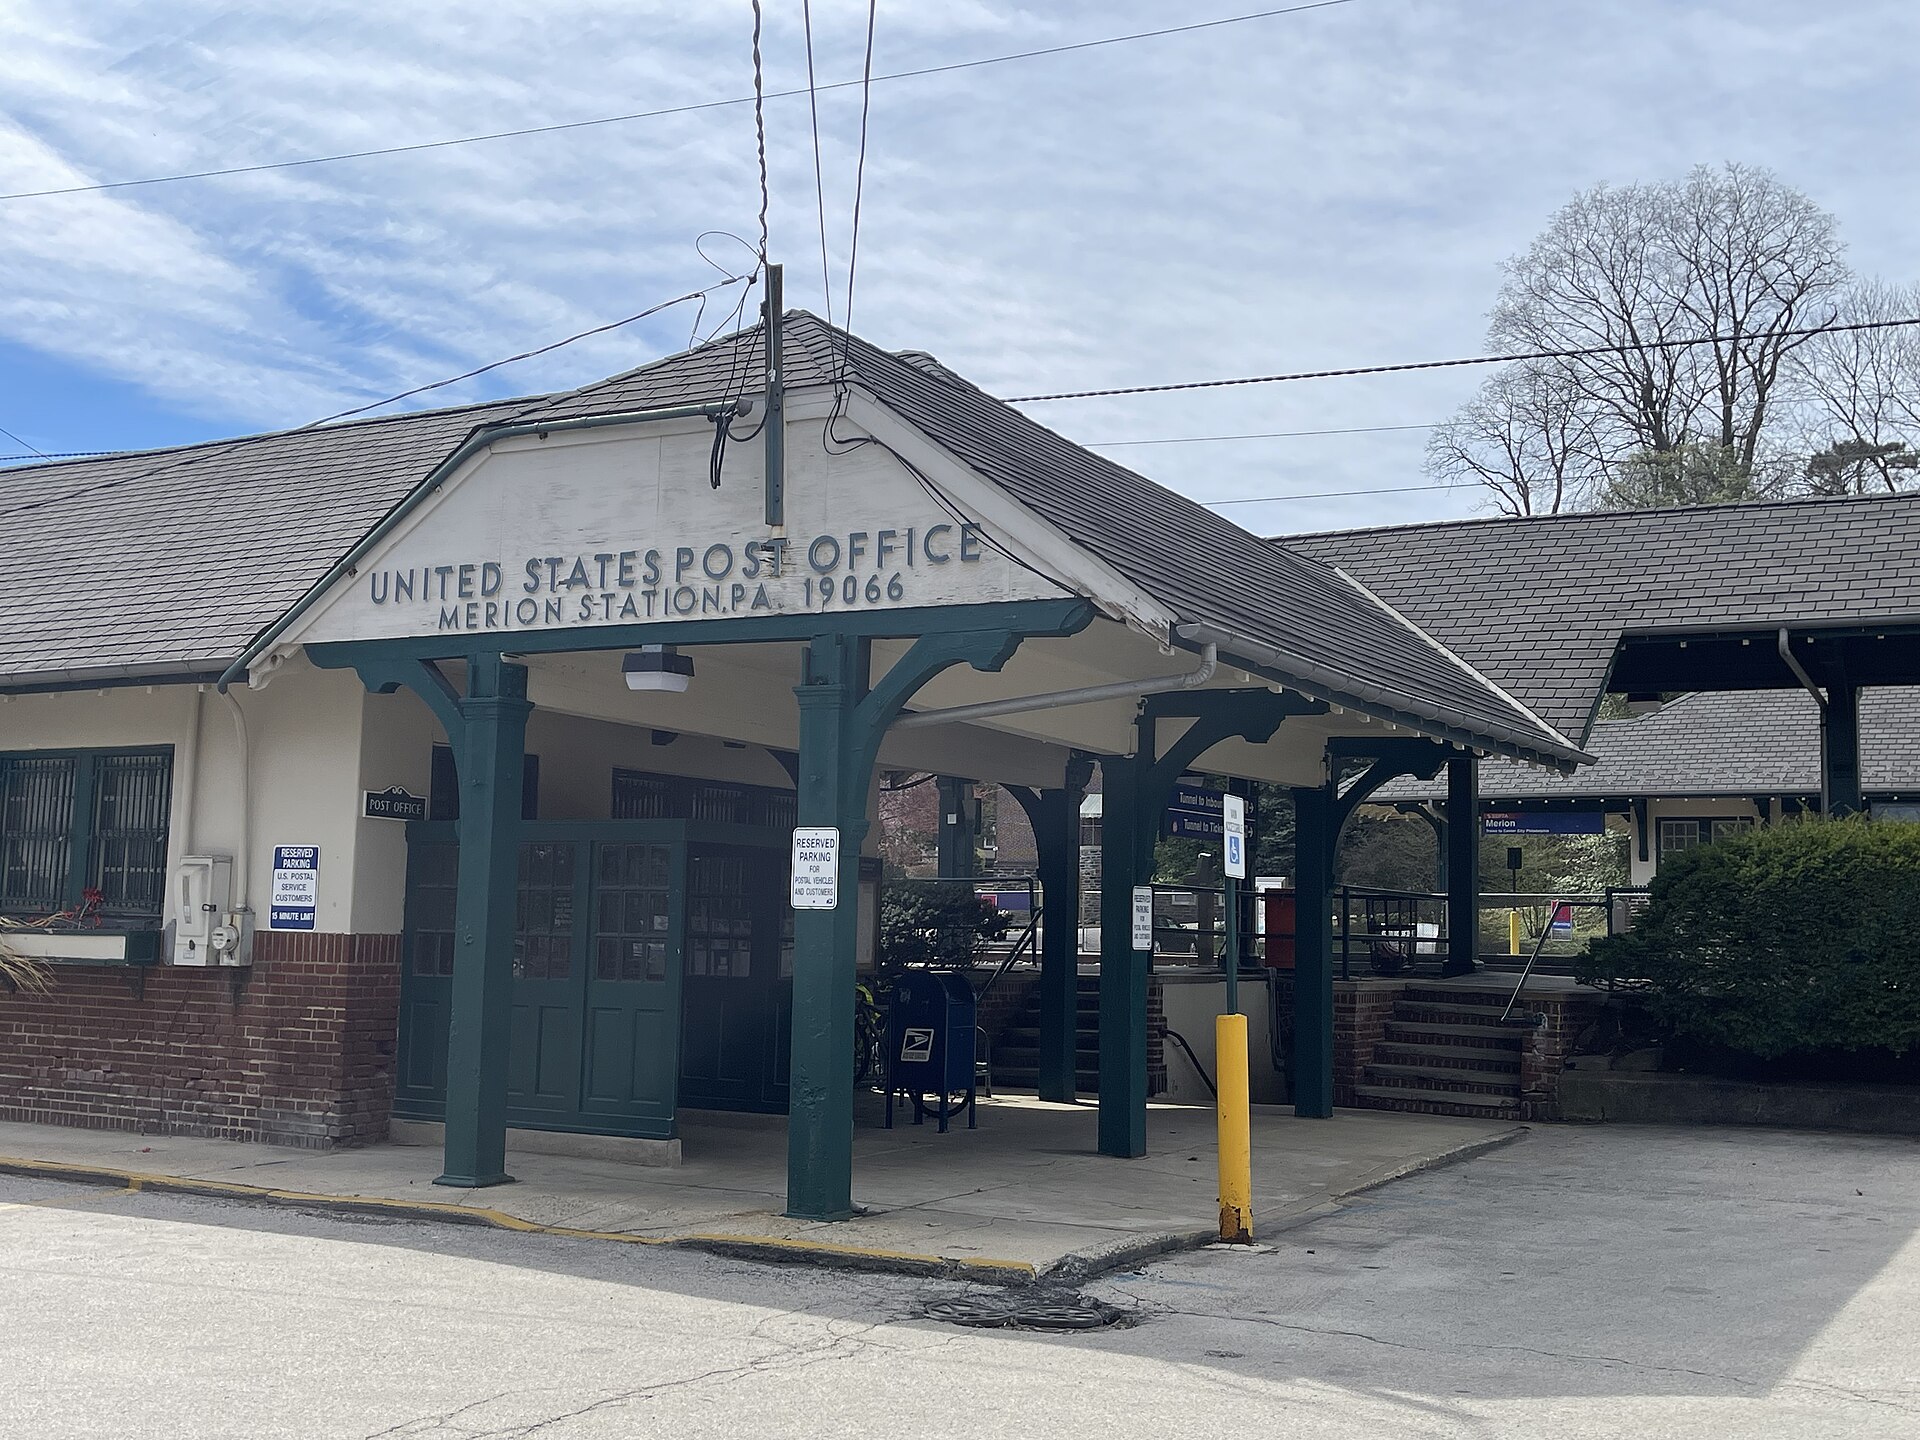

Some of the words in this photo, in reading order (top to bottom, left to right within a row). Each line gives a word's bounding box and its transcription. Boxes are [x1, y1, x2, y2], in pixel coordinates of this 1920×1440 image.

[371, 562, 502, 605] UNITED
[523, 551, 662, 594] STATES
[675, 538, 788, 583] POST
[808, 523, 982, 575] OFFICE
[438, 597, 562, 630] MERION
[803, 572, 904, 607] 19066
[369, 798, 390, 812] POST
[393, 801, 422, 815] OFFICE
[1485, 819, 1516, 827] Merion
[796, 838, 835, 848] RESERVED
[280, 848, 314, 858] RESERVED
[799, 852, 831, 862] PARKING
[282, 858, 311, 869] PARKING
[809, 865, 820, 873] FOR
[290, 872, 314, 880] POSTAL
[281, 883, 307, 891] SERVICE
[806, 888, 834, 896] CUSTOMERS
[275, 894, 313, 902] CUSTOMERS
[271, 911, 278, 920] 15
[279, 912, 299, 921] MINUTE
